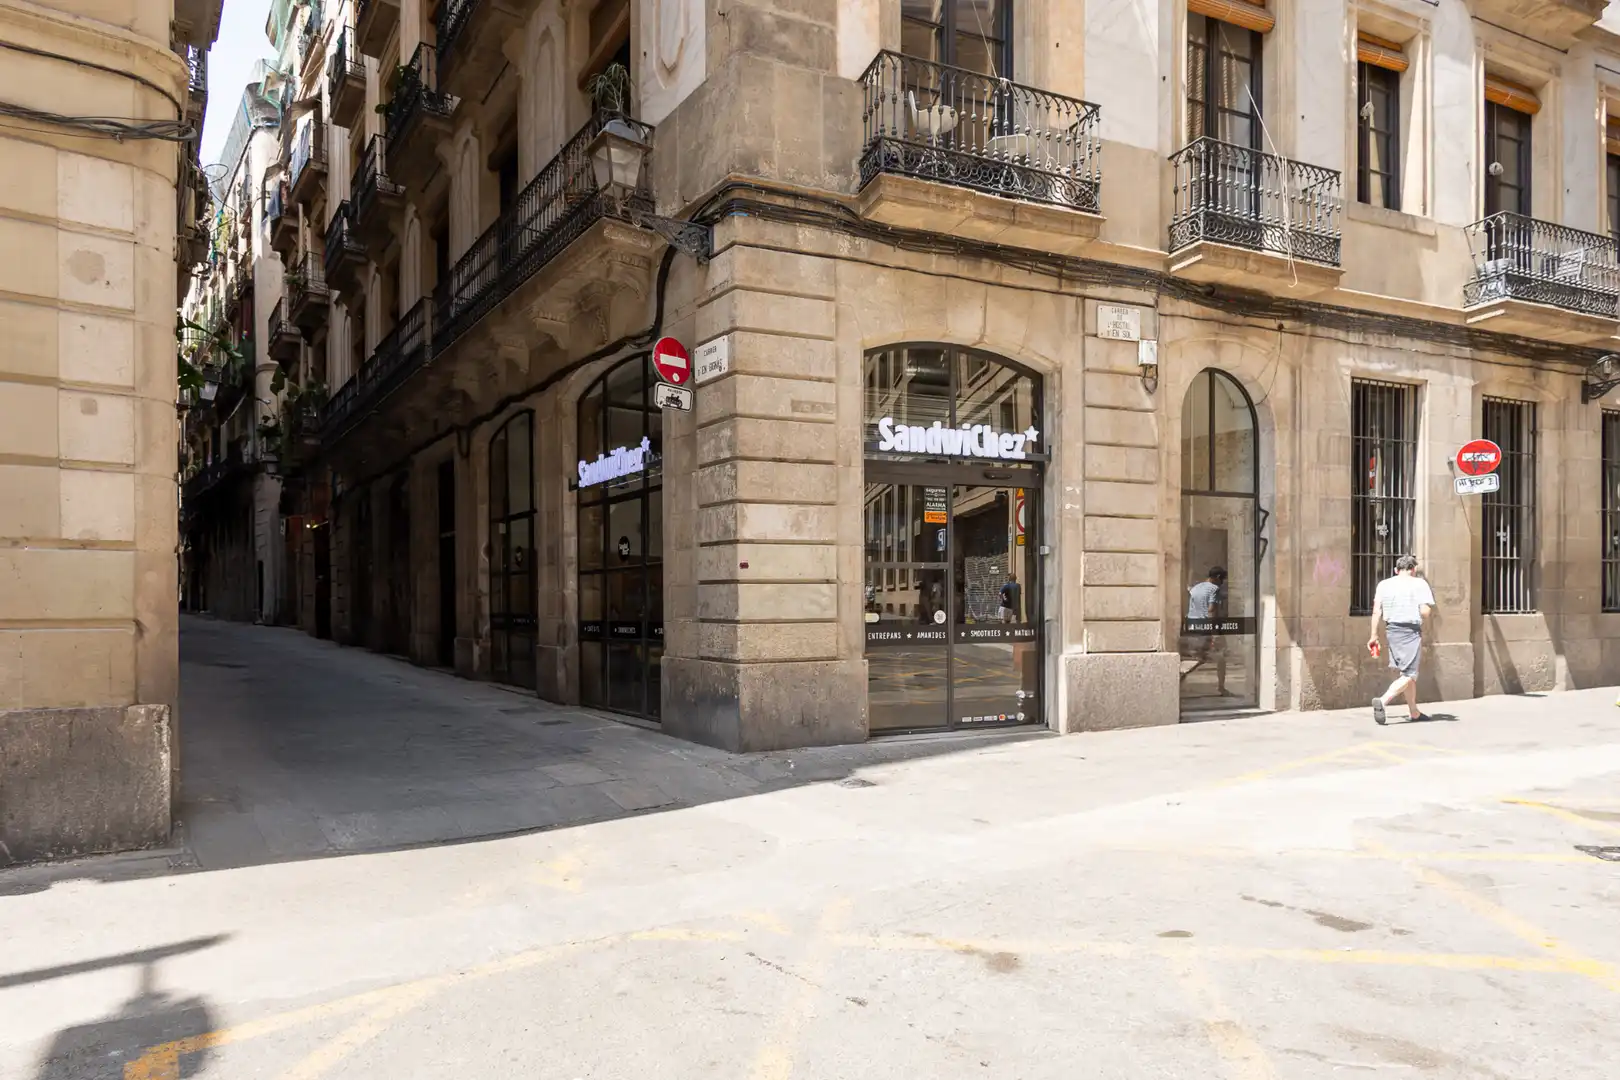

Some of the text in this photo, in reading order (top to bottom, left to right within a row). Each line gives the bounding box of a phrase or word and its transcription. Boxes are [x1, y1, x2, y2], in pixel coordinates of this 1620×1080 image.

[879, 416, 1026, 459] SandwiChez
[868, 631, 946, 640] ENTREPANS AMANIDES
[970, 629, 1001, 637] SMOOTHIES
